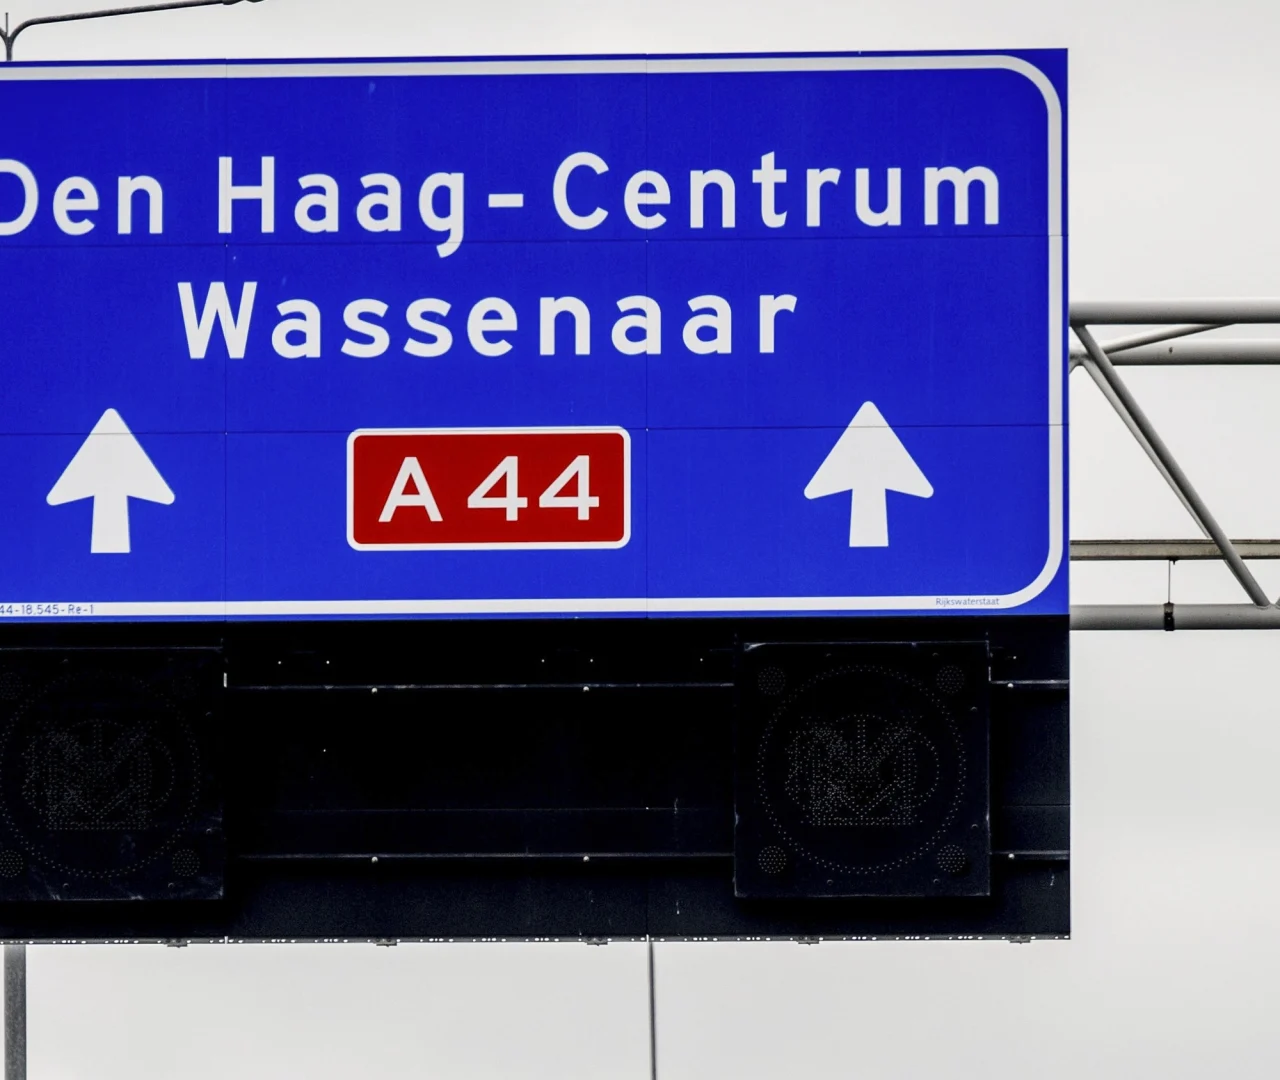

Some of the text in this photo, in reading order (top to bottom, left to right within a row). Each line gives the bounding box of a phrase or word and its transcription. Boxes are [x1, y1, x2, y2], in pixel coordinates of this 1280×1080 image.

[218, 151, 1000, 258] Haag-Centrum
[177, 281, 799, 359] Wassenaar
[935, 597, 1000, 607] Rijkswaterstaat
